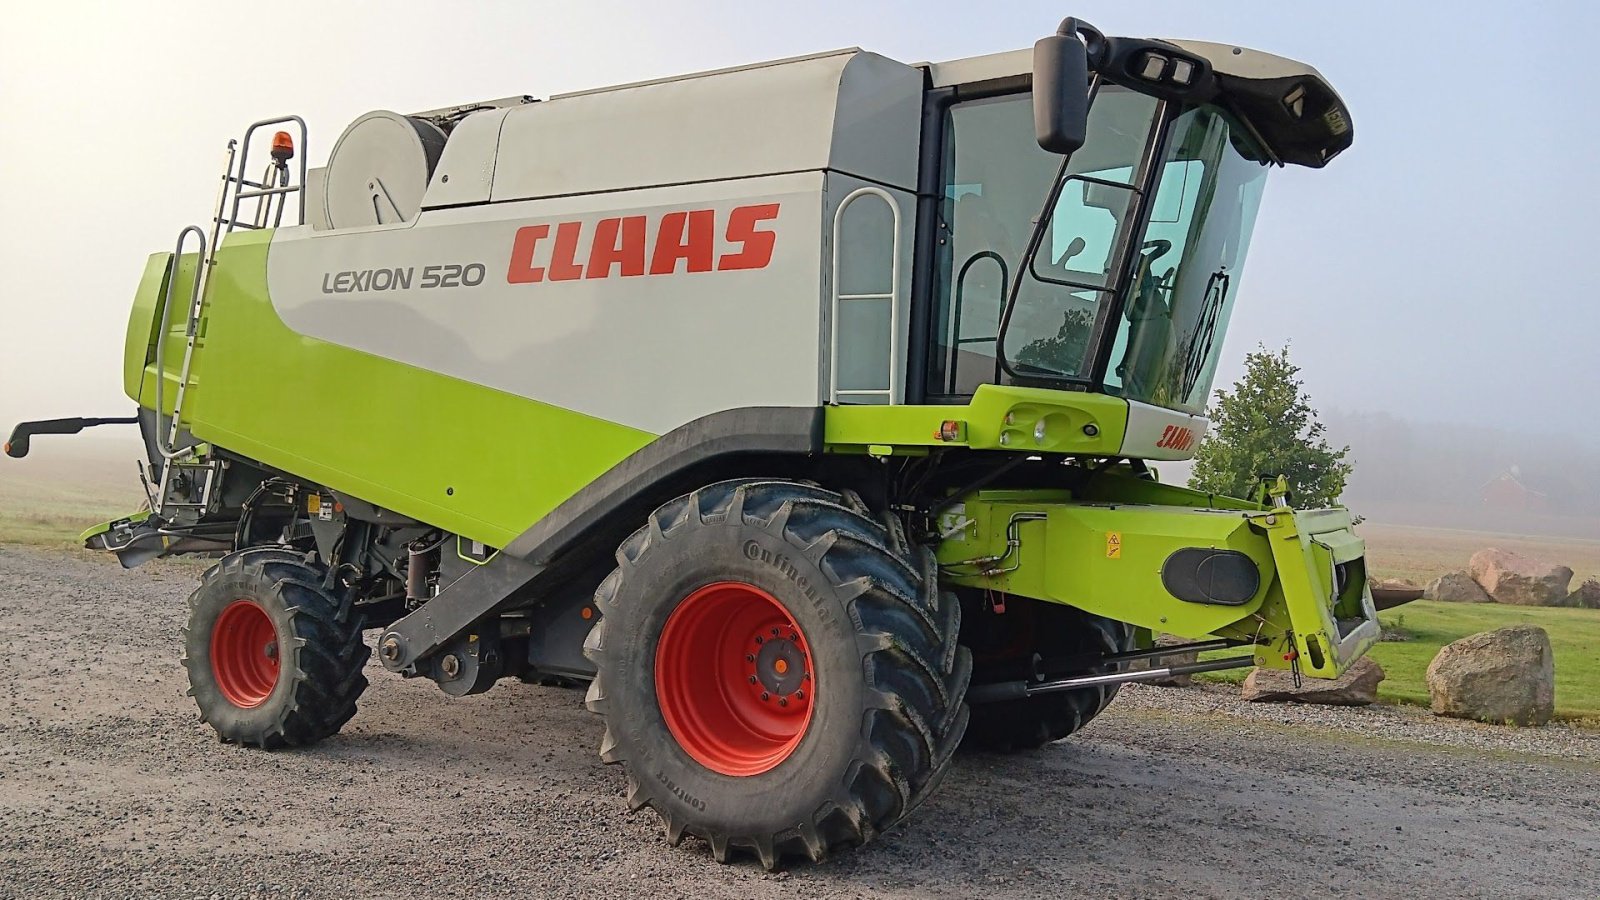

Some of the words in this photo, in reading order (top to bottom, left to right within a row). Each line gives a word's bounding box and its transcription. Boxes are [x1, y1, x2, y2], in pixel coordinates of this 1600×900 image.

[507, 203, 779, 284] CLAAS
[322, 266, 415, 293] LEXION
[420, 263, 485, 288] 520
